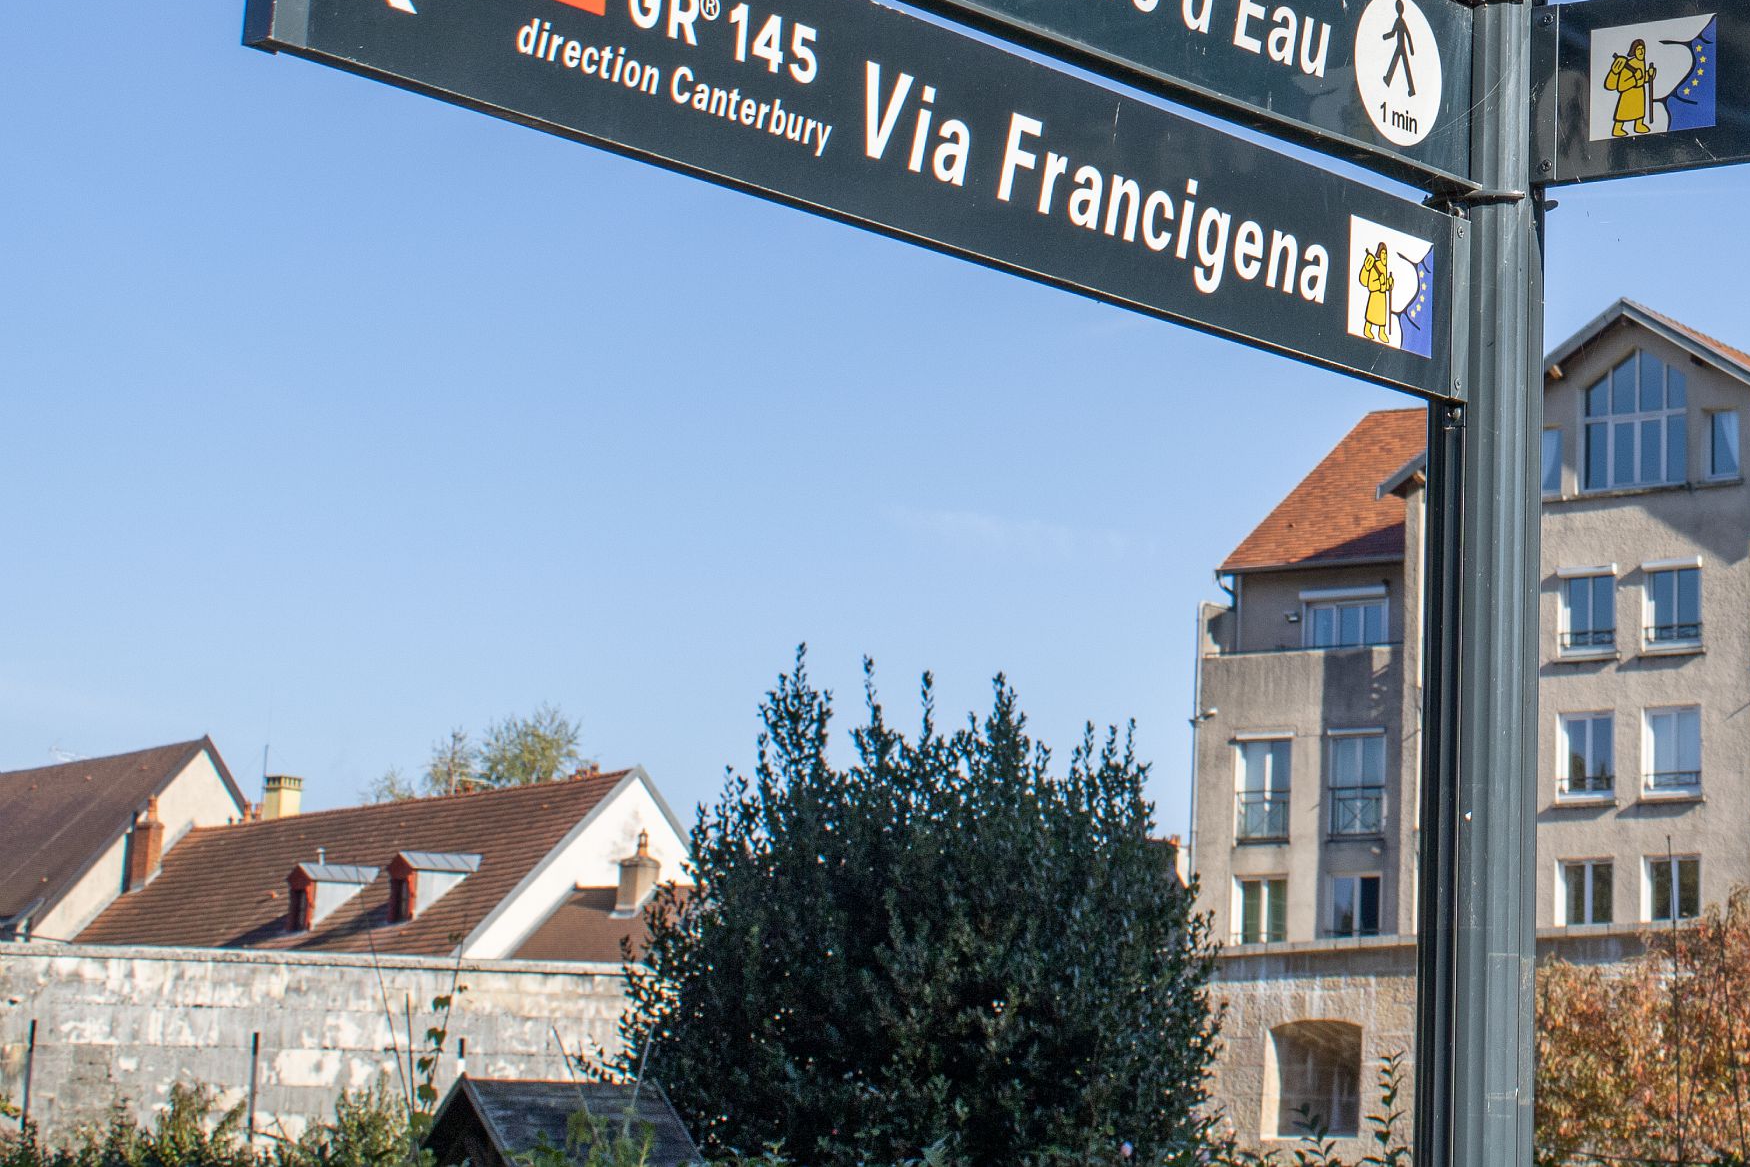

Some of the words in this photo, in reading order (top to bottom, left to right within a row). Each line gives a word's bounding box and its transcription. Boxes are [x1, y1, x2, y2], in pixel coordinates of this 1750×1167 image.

[517, 18, 659, 94] direction
[671, 66, 832, 156] Canterbury
[730, 3, 817, 83] 145
[1380, 101, 1387, 123] 1
[1391, 110, 1418, 134] min
[867, 61, 969, 186] Via
[998, 112, 1330, 304] Francigena
